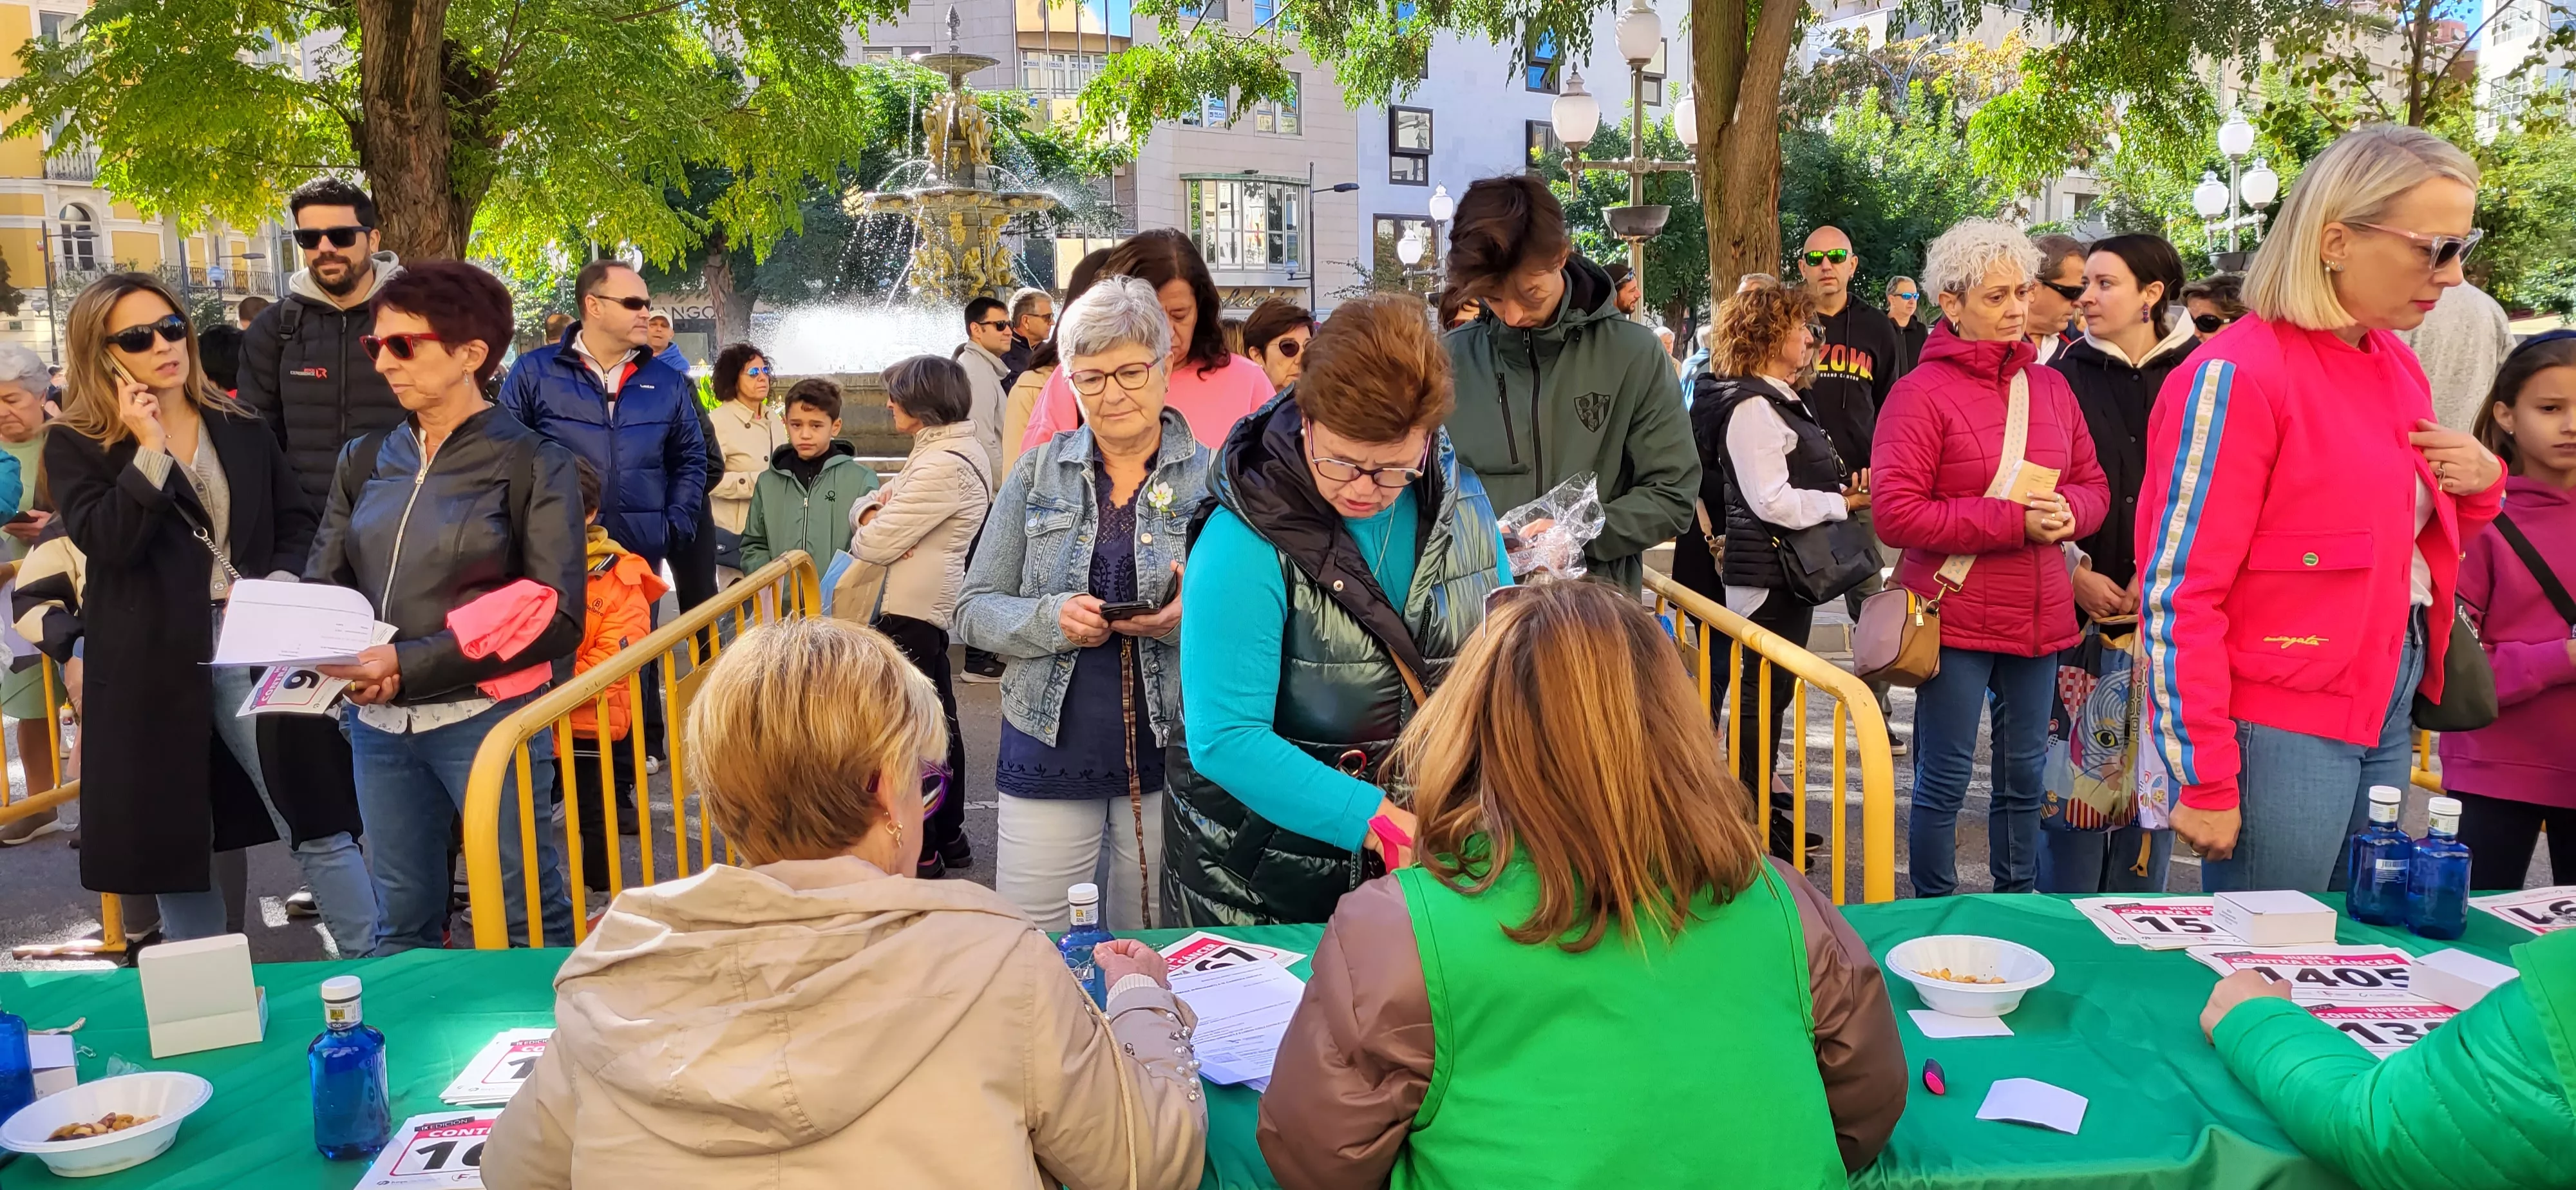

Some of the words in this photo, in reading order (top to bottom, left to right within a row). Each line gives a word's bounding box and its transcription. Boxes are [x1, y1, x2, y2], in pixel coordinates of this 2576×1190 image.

[650, 305, 716, 320] NGO
[2132, 916, 2216, 934] 15
[1177, 943, 1220, 964] CÁNCER
[2331, 957, 2400, 965] CÁNCER
[2336, 1022, 2447, 1044] 13
[430, 1118, 468, 1129] EDICIÓN
